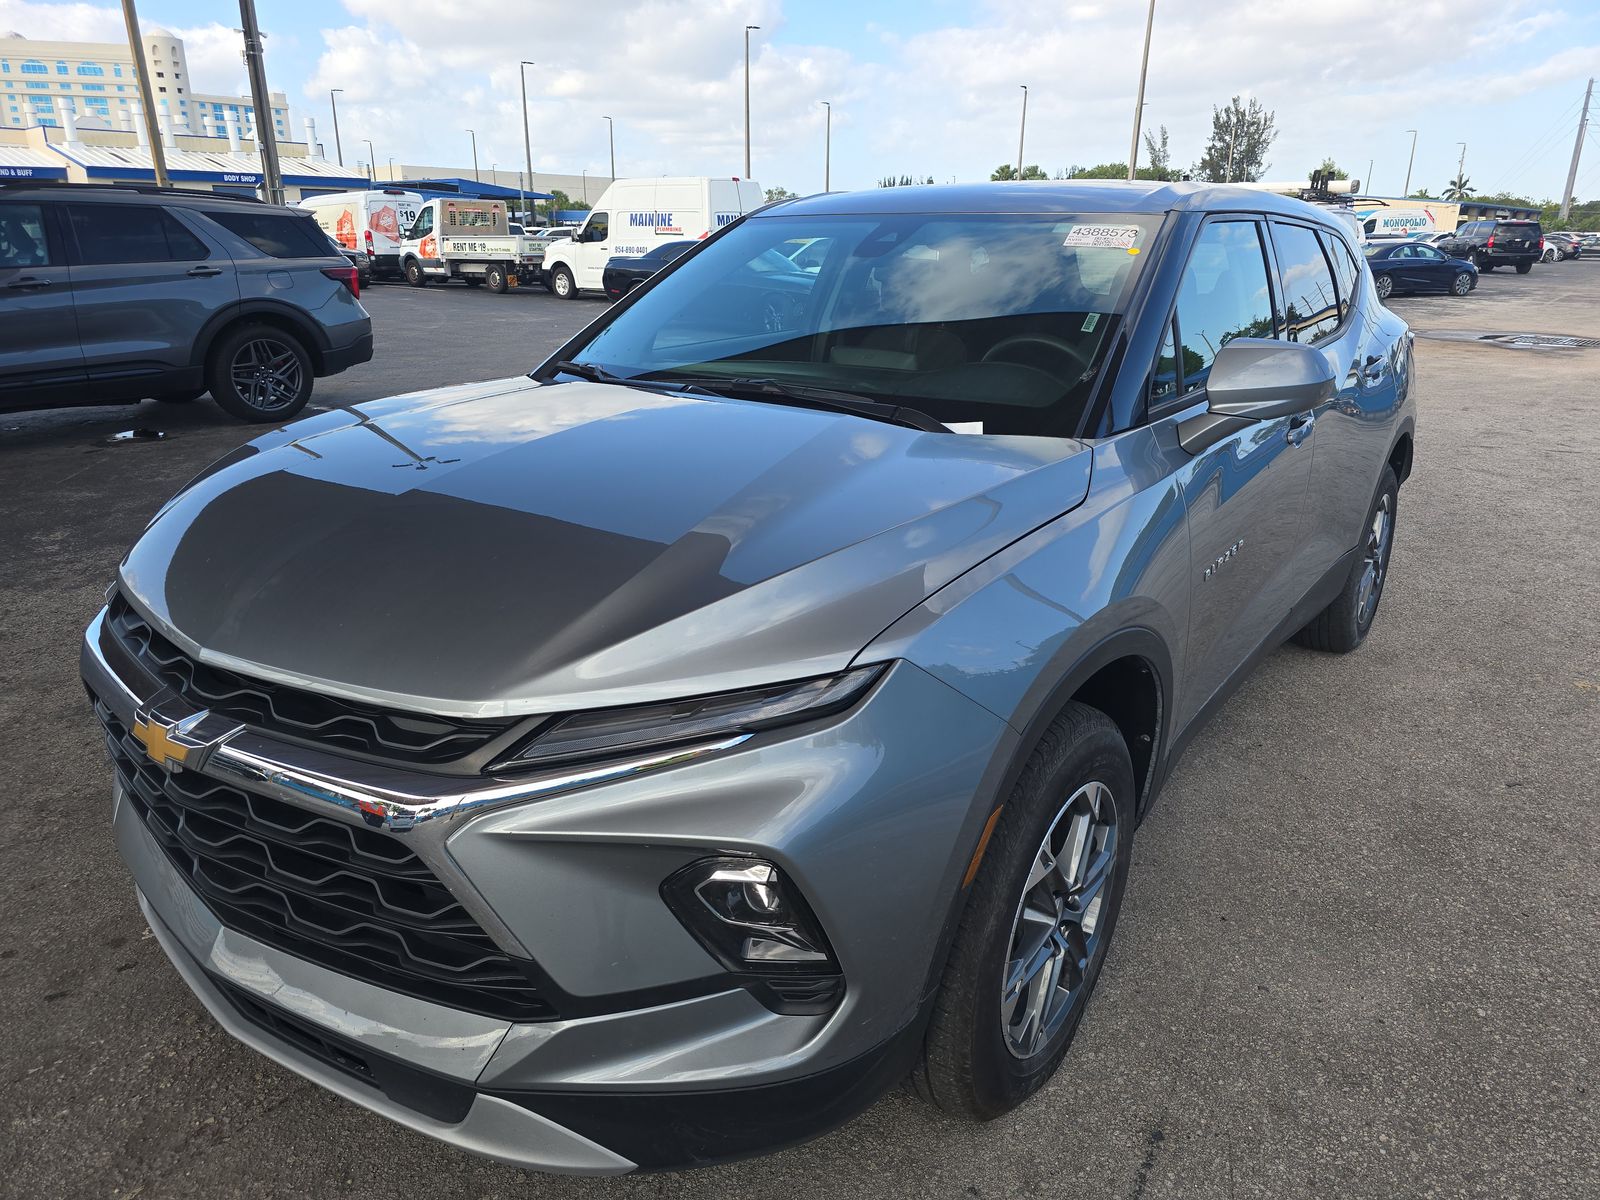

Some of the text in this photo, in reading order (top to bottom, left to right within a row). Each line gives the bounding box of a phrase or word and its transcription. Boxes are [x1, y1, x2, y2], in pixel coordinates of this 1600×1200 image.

[0, 168, 9, 176] ND
[17, 169, 33, 177] BUFF
[223, 174, 256, 183] BODY SHOP
[399, 210, 416, 222] $19
[716, 214, 739, 226] MAI
[1383, 217, 1427, 228] MONOPOLIO
[1072, 227, 1138, 238] 4388573
[452, 242, 467, 252] RENT
[468, 242, 477, 252] ME
